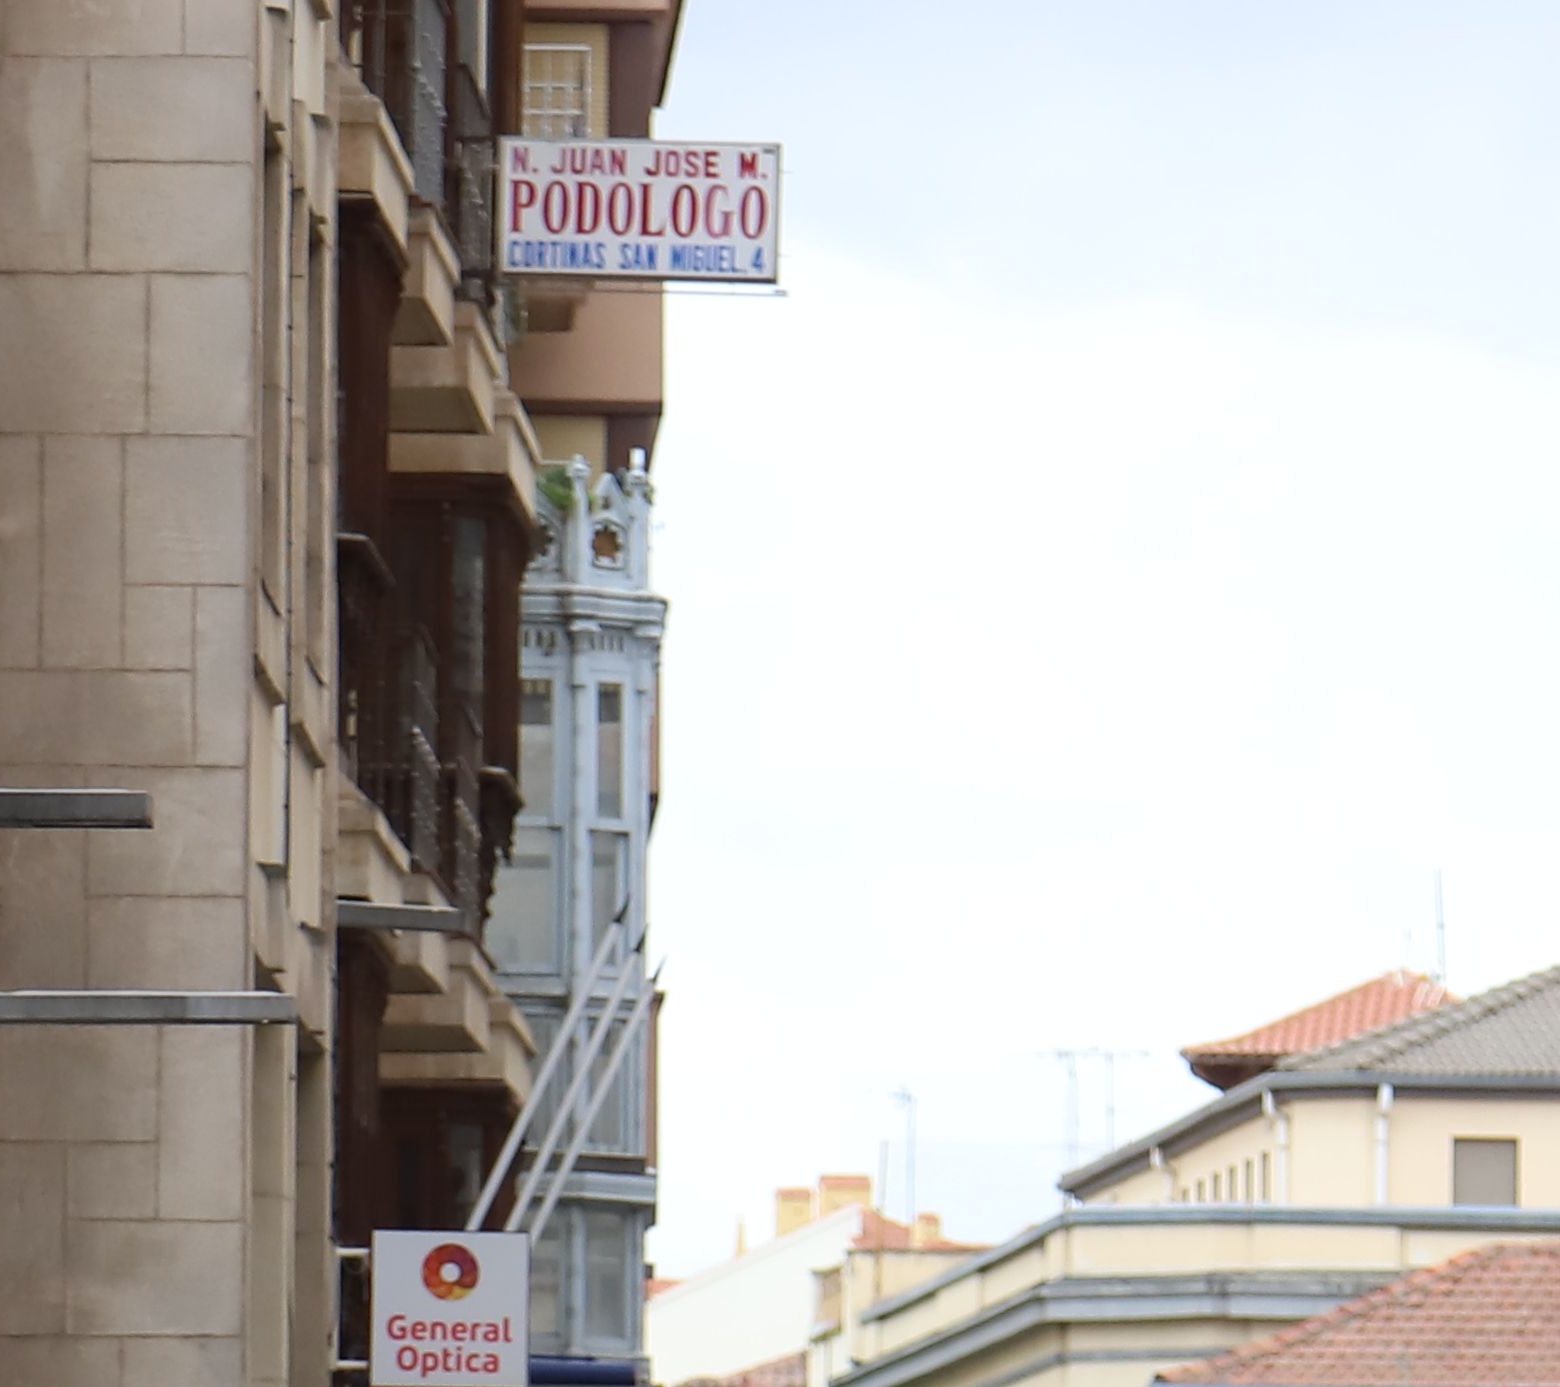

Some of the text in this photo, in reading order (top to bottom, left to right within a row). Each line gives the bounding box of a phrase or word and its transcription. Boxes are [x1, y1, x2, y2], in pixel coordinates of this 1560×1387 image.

[551, 148, 627, 176] JUAN
[644, 150, 720, 178] JOSE
[510, 179, 769, 240] PODOLOGO
[509, 240, 607, 270] CORTINAS
[618, 242, 658, 271] SAN
[752, 246, 764, 272] 4
[386, 1314, 513, 1344] General
[396, 1346, 500, 1378] Optica
